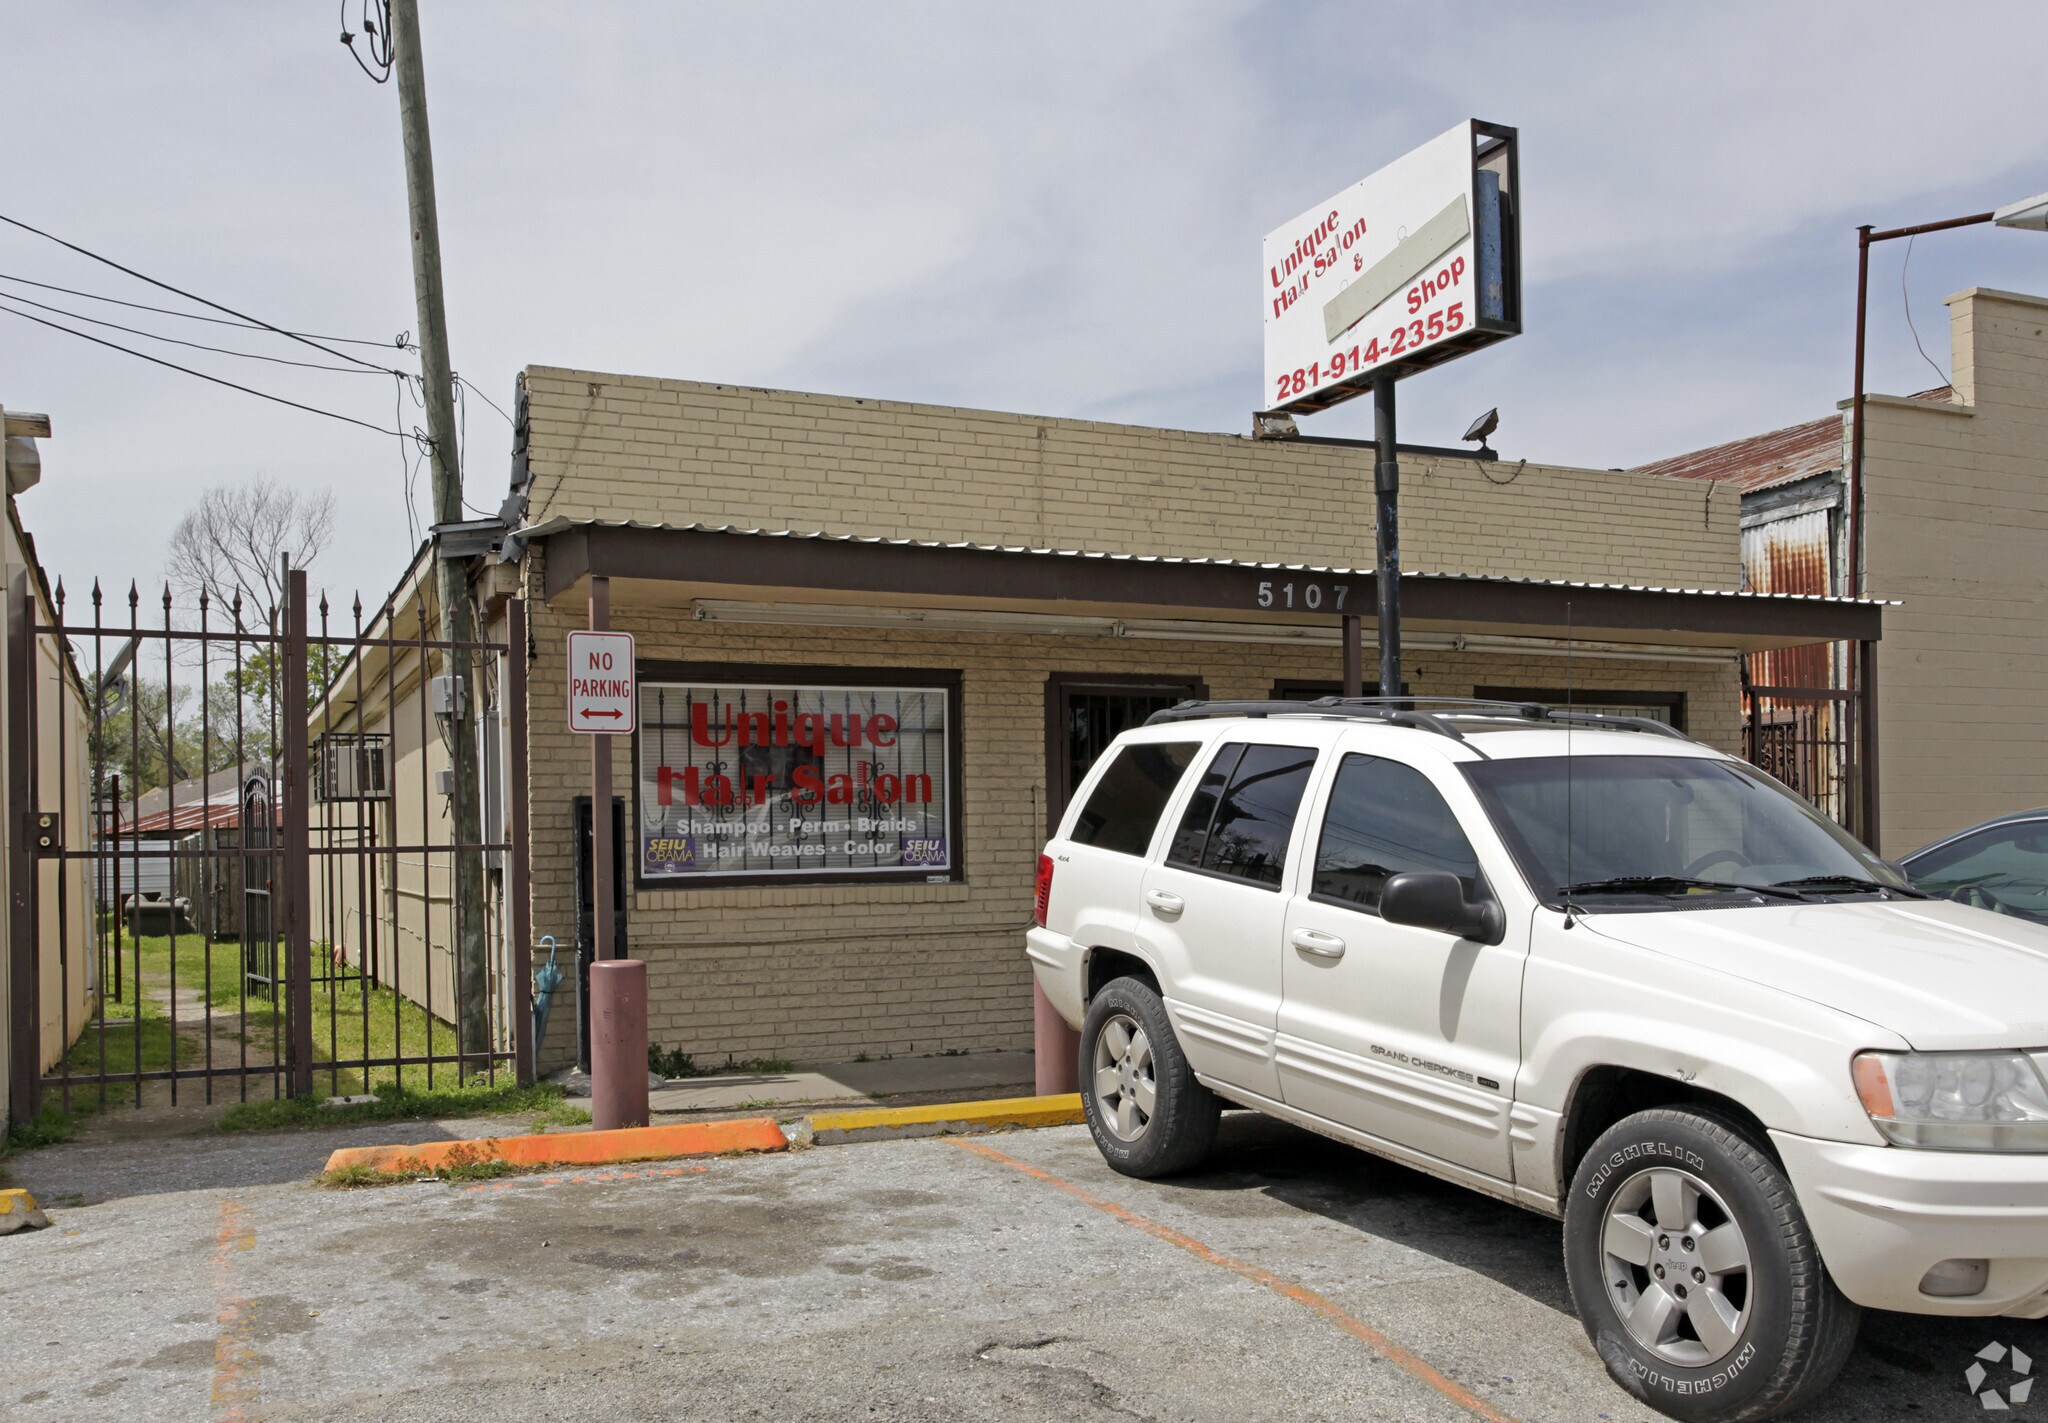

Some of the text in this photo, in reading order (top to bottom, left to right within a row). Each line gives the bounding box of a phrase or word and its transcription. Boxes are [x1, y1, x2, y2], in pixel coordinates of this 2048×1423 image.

[1271, 210, 1339, 288] Unique
[1353, 253, 1363, 272] &
[1273, 217, 1367, 319] Hair Salon
[1407, 256, 1465, 315] Shop
[1276, 302, 1464, 400] 281-914-2355
[1258, 581, 1348, 610] 5107
[589, 652, 613, 671] NO
[573, 679, 629, 698] PARKING
[691, 700, 897, 756] Unique
[657, 760, 932, 807] Hair Salon
[677, 817, 917, 838] Shampoo Perm Braids
[647, 849, 694, 862] OBAMA
[649, 839, 686, 850] SEIU
[703, 839, 894, 859] Hair Weaves Color
[905, 850, 946, 861] OBAMA
[906, 840, 939, 850] SEIU
[1371, 1044, 1408, 1063] GRAND
[1411, 1057, 1473, 1083] CHEROKEE
[1586, 1142, 1704, 1198] MICHELIN
[1627, 1342, 1756, 1394] MICHELIN
